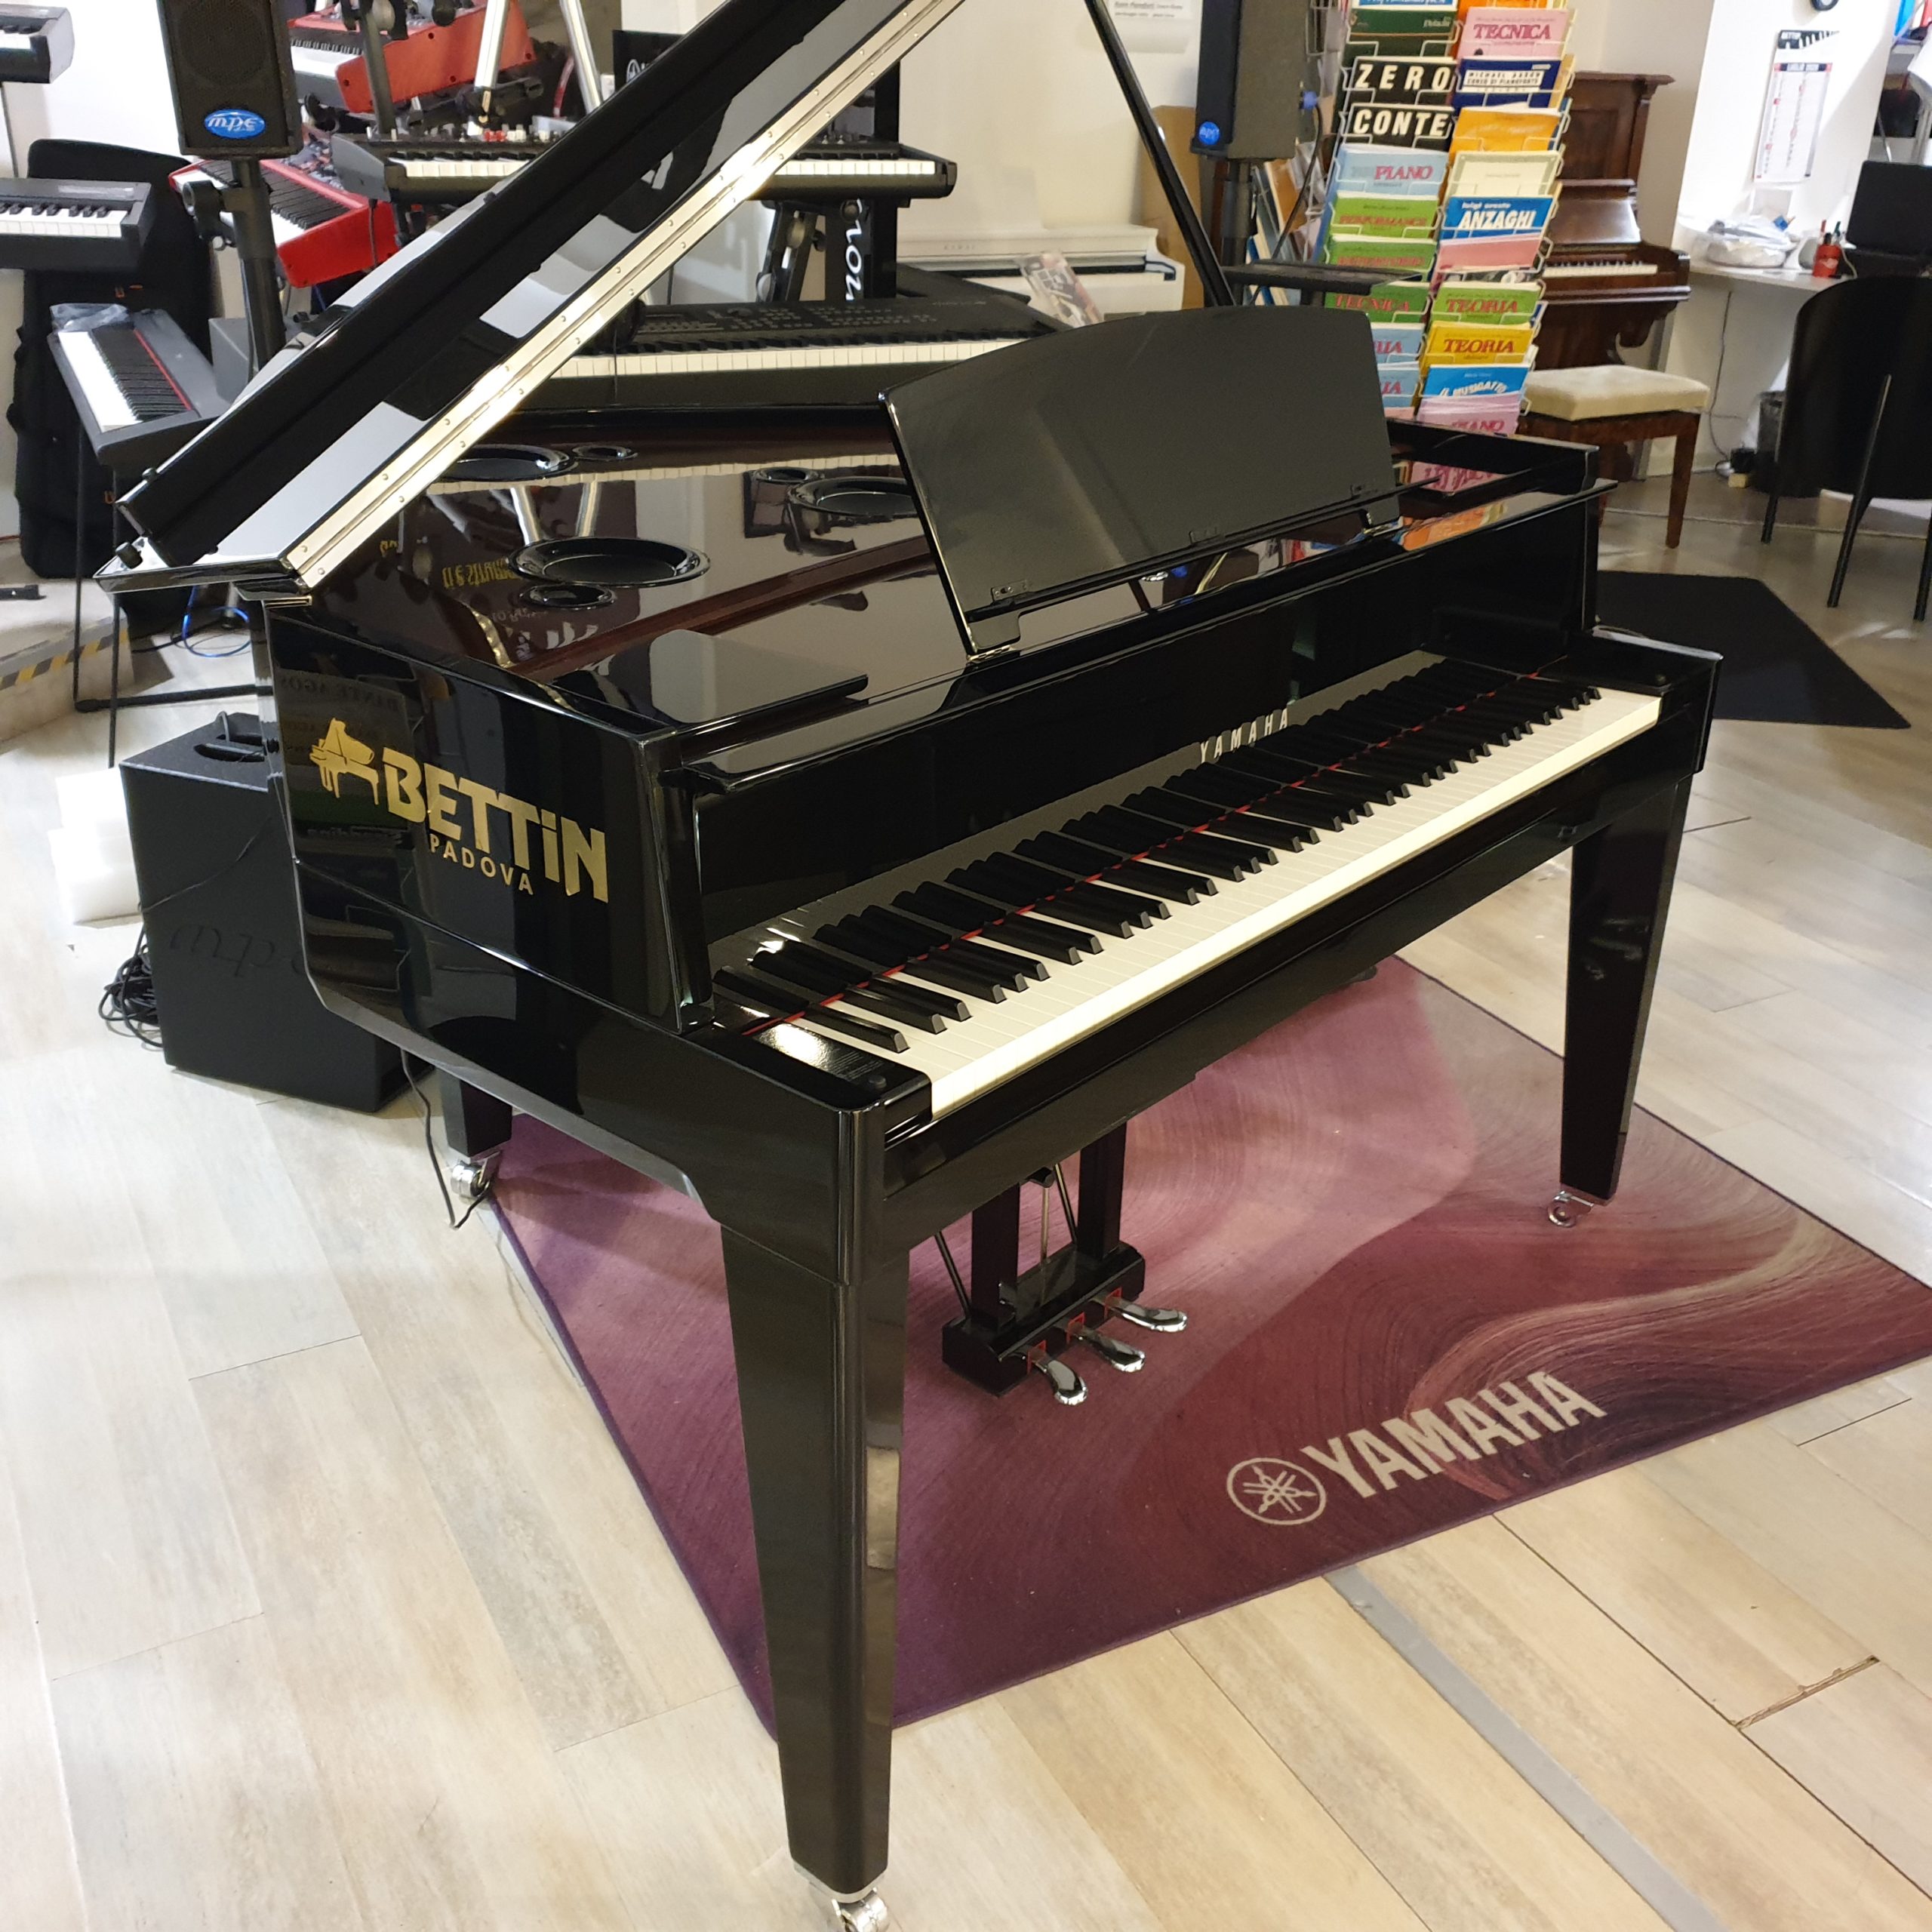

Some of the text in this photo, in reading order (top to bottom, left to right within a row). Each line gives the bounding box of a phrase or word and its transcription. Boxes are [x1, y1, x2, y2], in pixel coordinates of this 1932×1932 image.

[1473, 23, 1552, 40] TECNICA
[1355, 63, 1451, 92] ZERO
[1353, 109, 1449, 137] CONTE
[1374, 165, 1434, 180] PIANO
[1457, 210, 1537, 230] ANZAGHI
[1447, 299, 1518, 313] TEORIA
[1444, 338, 1515, 353] TEORIA
[1200, 707, 1288, 764] YAMAHA
[430, 832, 534, 896] PADOVA
[1300, 1371, 1608, 1499] YAMAHA
